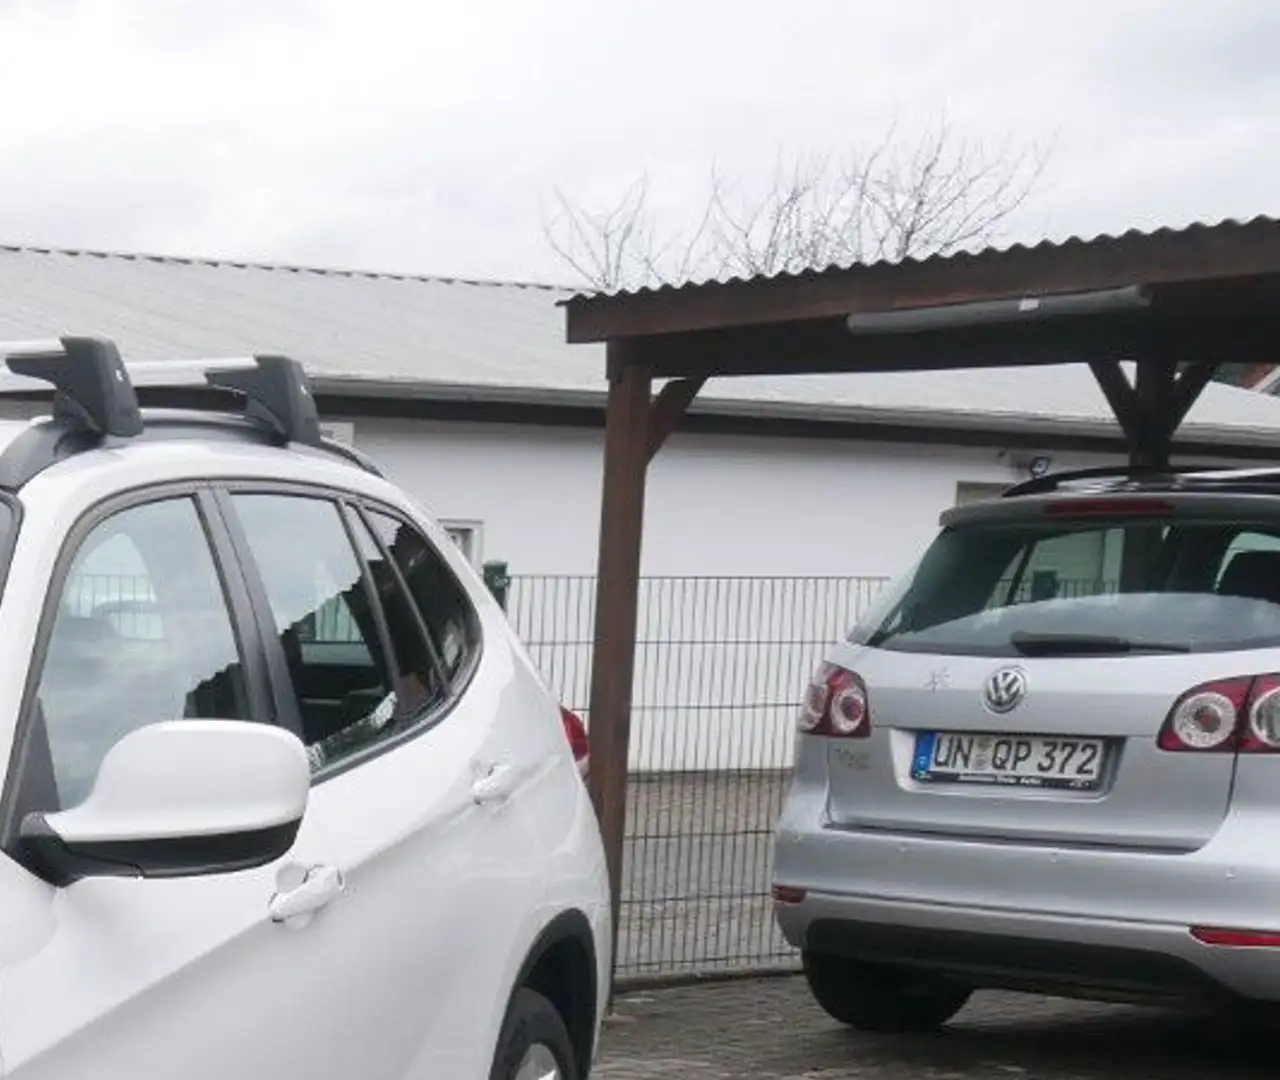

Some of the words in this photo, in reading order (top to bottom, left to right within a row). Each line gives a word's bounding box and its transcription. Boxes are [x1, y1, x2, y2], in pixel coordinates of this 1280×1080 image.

[934, 735, 974, 769] UN
[992, 738, 1032, 772] QP
[1037, 740, 1098, 775] 372
